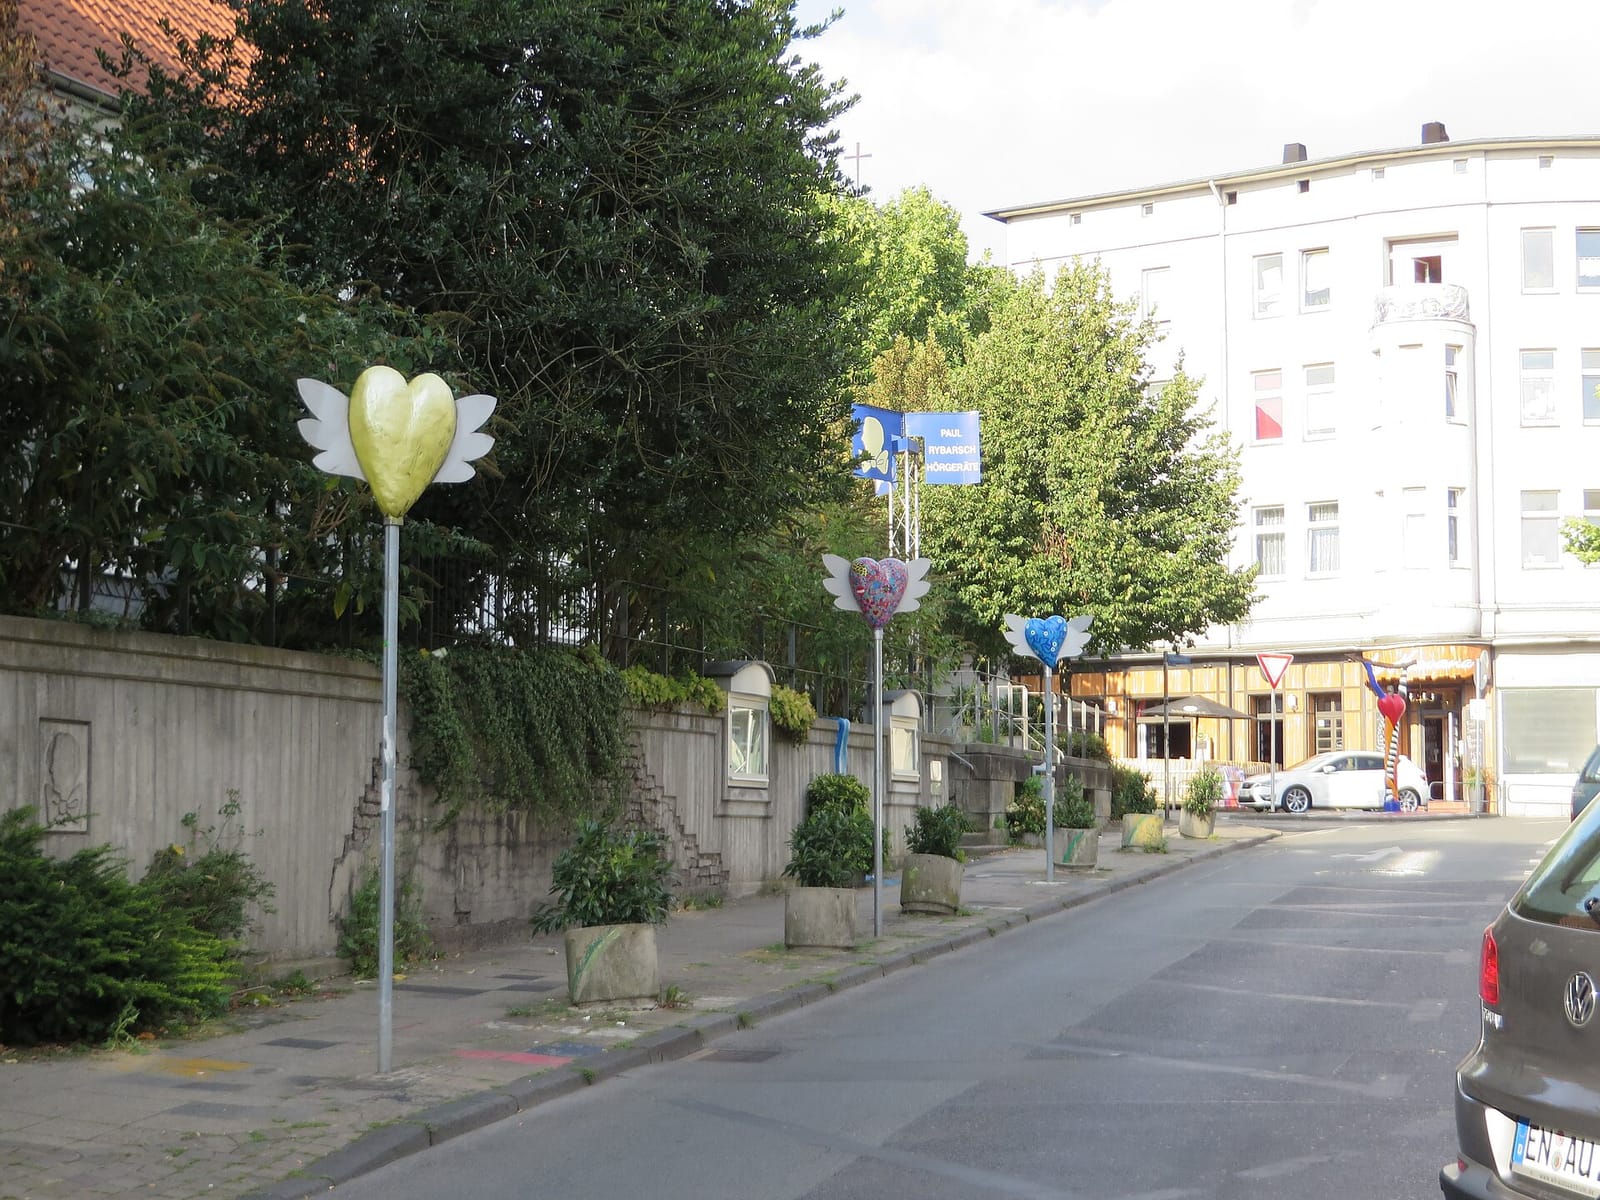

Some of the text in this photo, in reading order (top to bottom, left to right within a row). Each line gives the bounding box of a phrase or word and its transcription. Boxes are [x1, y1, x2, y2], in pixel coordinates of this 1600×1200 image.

[941, 429, 962, 438] PAUL
[929, 446, 976, 455] RYBARSCH
[927, 462, 978, 472] HÖRGERÄTE
[1525, 1126, 1595, 1178] EN AU
